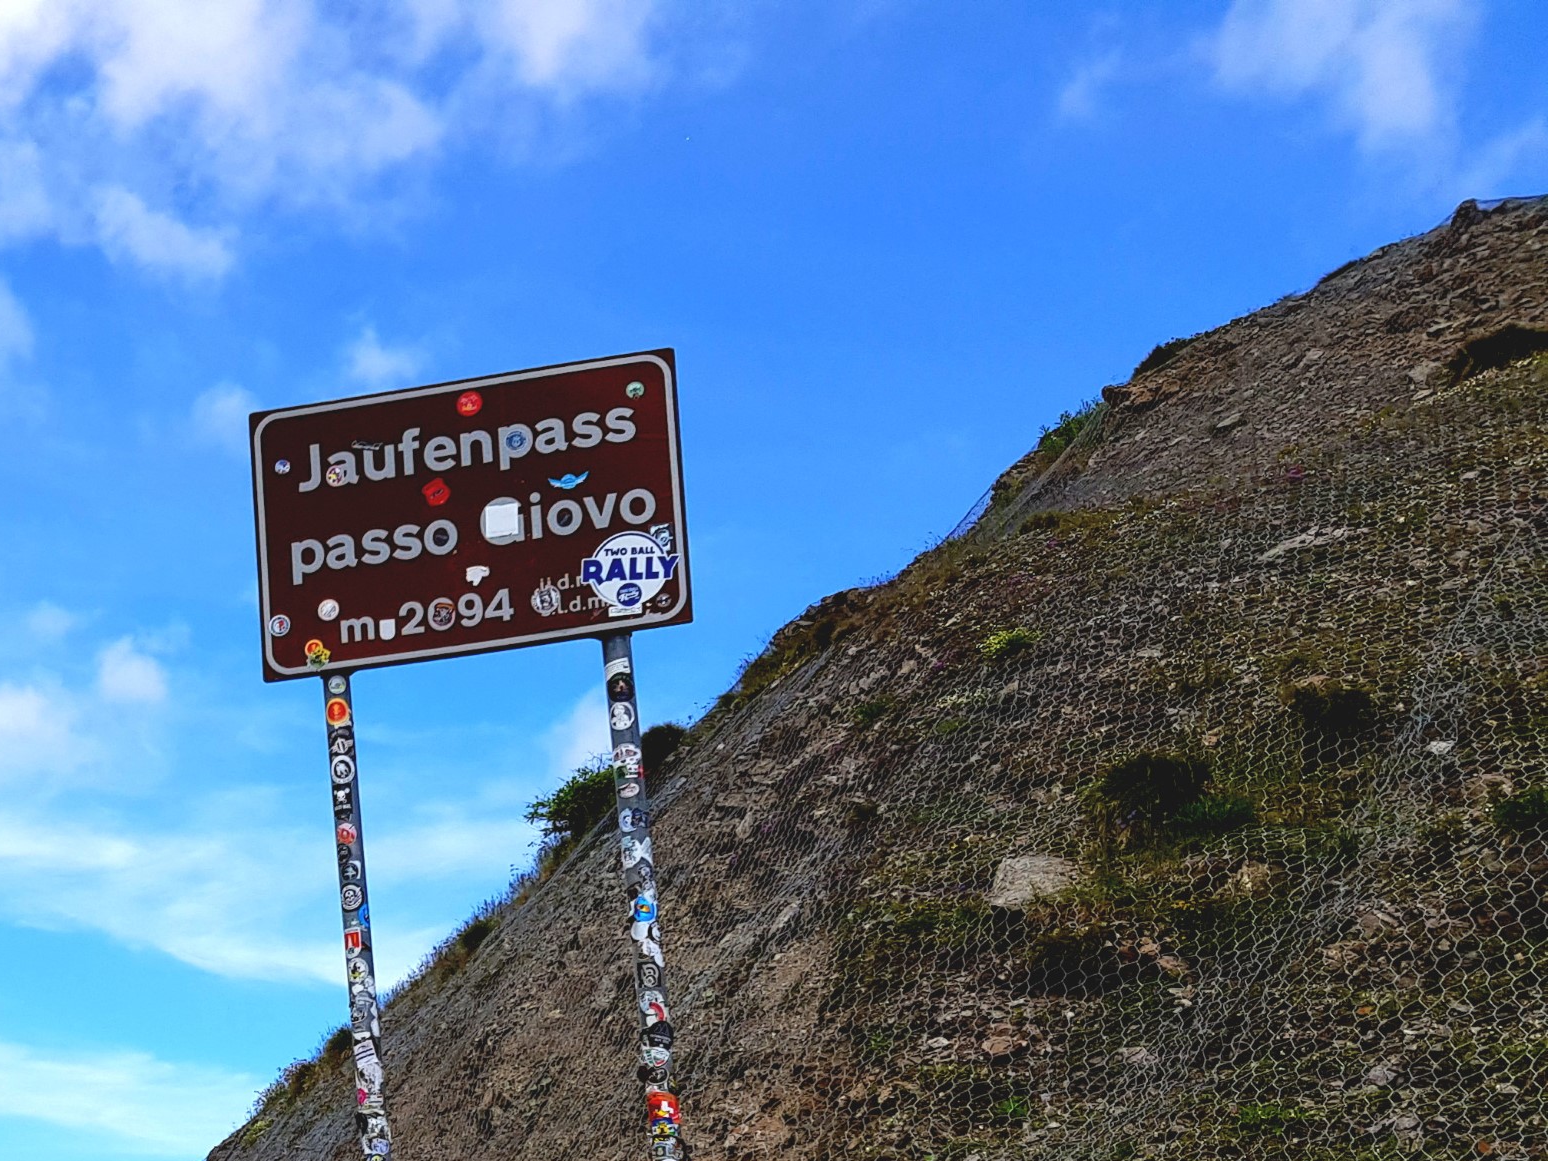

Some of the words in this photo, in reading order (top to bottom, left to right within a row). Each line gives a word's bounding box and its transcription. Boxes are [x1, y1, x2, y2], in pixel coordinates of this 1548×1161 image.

[298, 406, 637, 493] Jaufenpass
[291, 518, 459, 586] passo
[582, 555, 679, 585] RALLY
[604, 548, 628, 557] TWO
[631, 546, 655, 555] BALL
[398, 588, 514, 636] 2094
